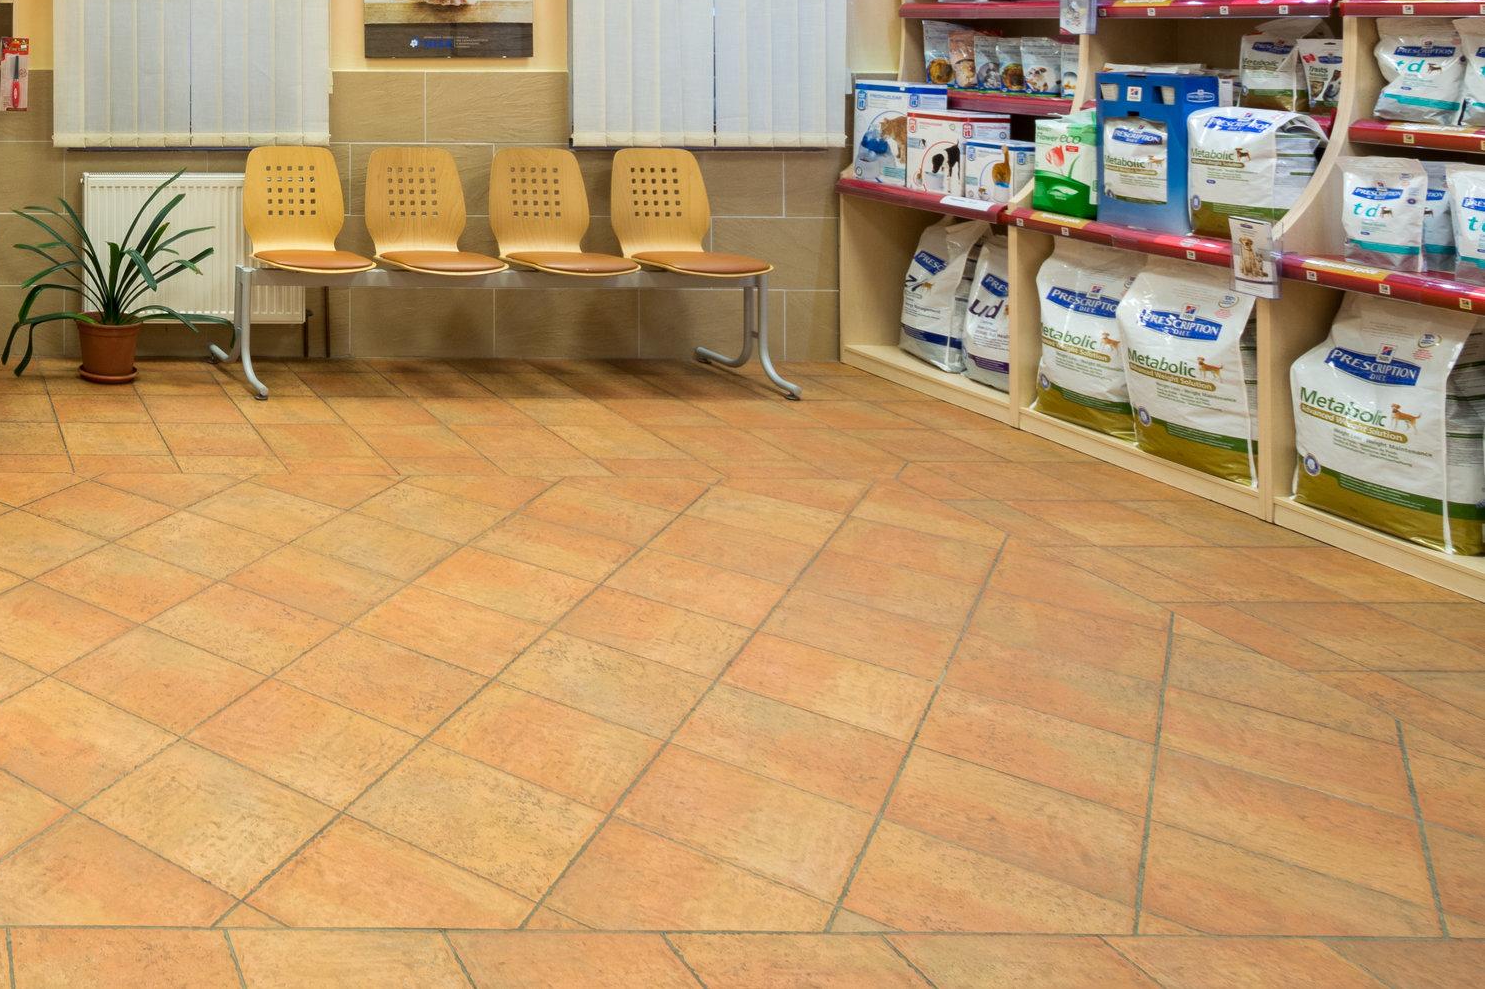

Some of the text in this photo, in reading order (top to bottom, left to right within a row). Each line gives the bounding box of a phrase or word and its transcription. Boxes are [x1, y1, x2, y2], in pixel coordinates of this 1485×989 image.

[1059, 134, 1082, 144] eco
[1190, 147, 1234, 161] Metabolic
[1052, 289, 1118, 312] PRESCRIPTIO
[1078, 305, 1096, 313] DIET
[1041, 328, 1098, 351] etabolic
[1127, 347, 1197, 379] Metabolic
[1331, 349, 1417, 379] PRESCRIPTION
[1179, 376, 1213, 392] Solution
[1369, 373, 1386, 381] DIET
[1300, 386, 1388, 427] Metabolic
[1368, 425, 1404, 442] Solution
